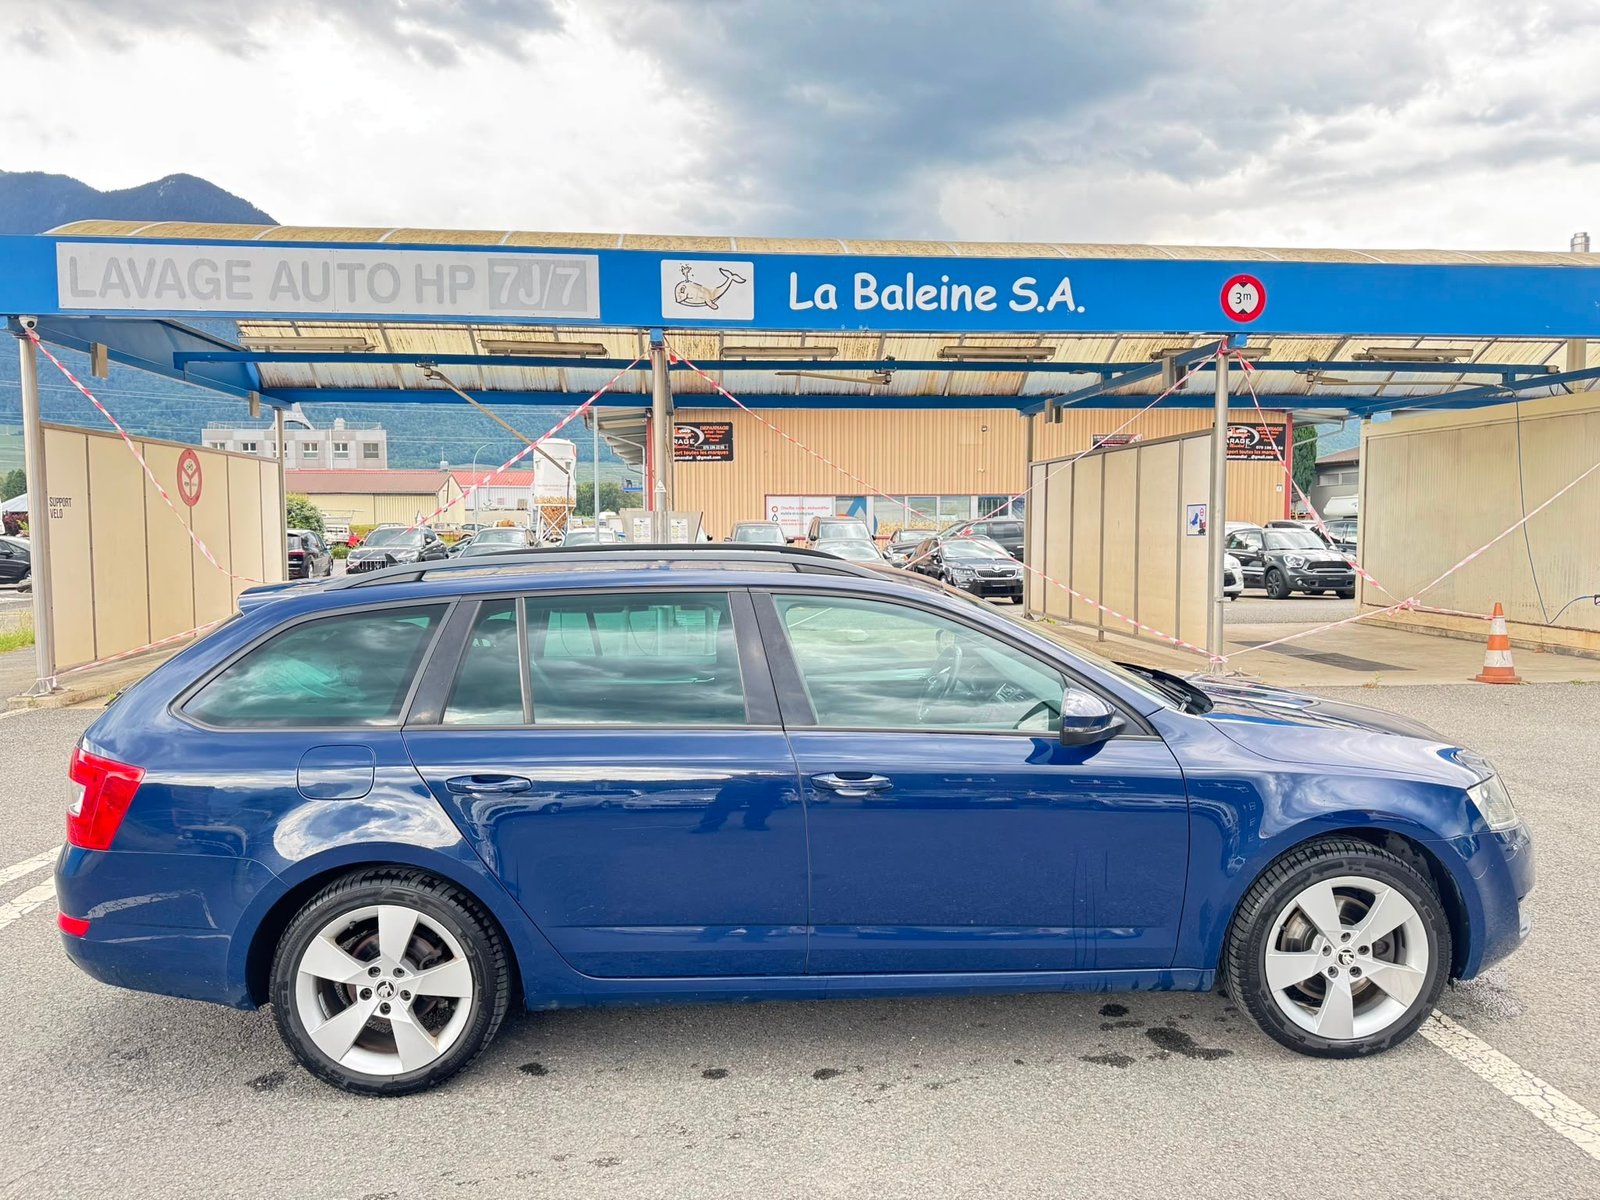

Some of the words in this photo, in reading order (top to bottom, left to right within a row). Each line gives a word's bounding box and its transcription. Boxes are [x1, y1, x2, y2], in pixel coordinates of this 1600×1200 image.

[68, 256, 253, 300] LAVAGE
[268, 259, 401, 304] AUTO
[414, 263, 476, 305] HP
[493, 264, 581, 309] 7J/7
[789, 271, 838, 310] La
[853, 271, 998, 311] Baleine
[1008, 276, 1086, 313] S.A.
[49, 496, 72, 508] SUPPORT
[49, 508, 64, 519] VELO
